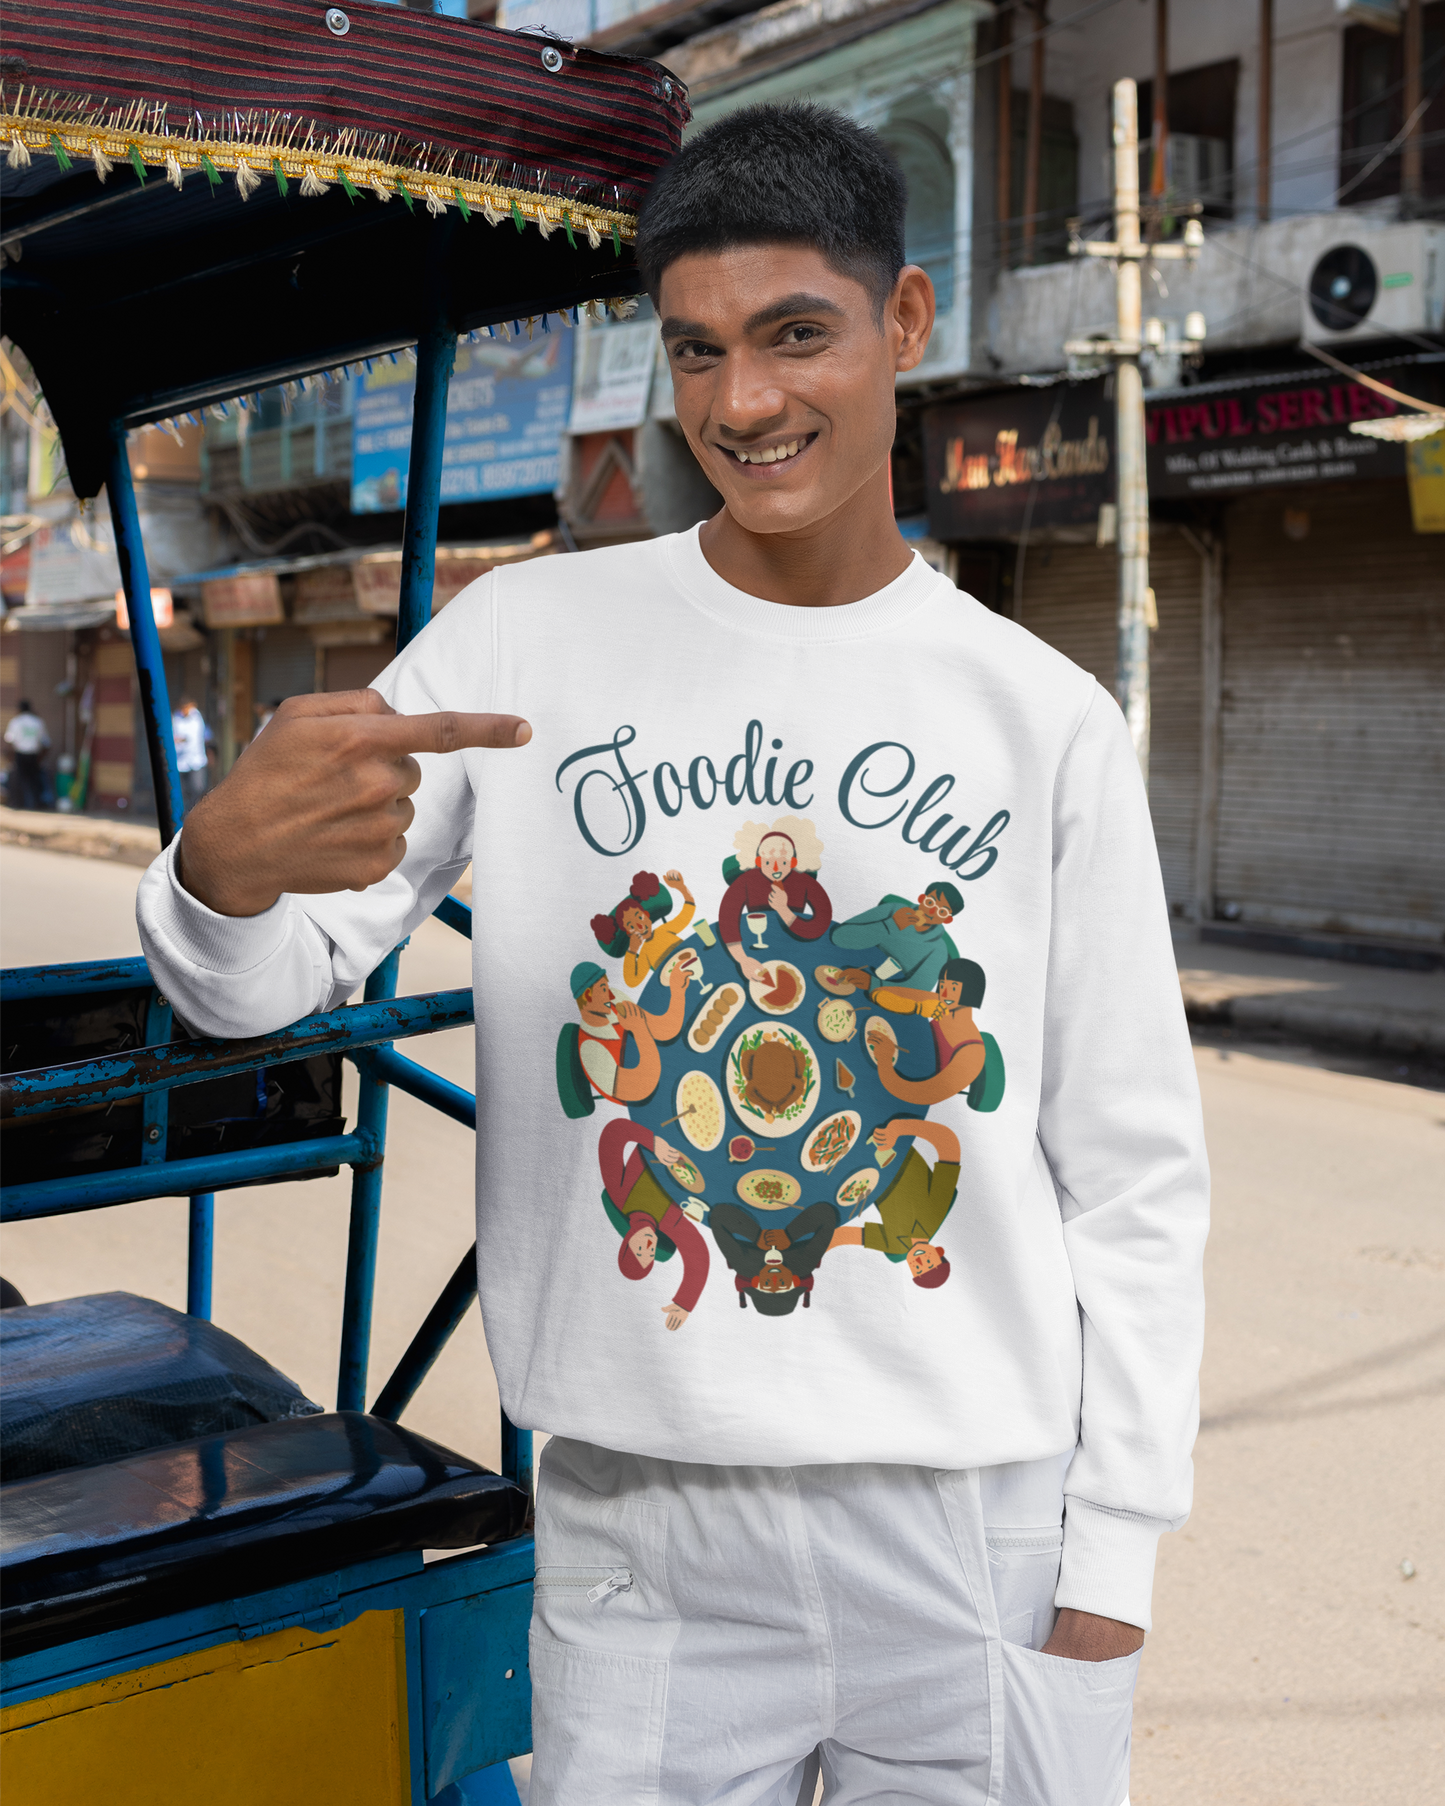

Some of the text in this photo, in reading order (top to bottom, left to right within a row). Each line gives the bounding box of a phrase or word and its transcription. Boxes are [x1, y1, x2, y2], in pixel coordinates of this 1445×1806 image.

[1146, 378, 1397, 445] VIPUL SERIES
[1221, 446, 1278, 469] Wedding
[556, 719, 1011, 881] Foodie Club
